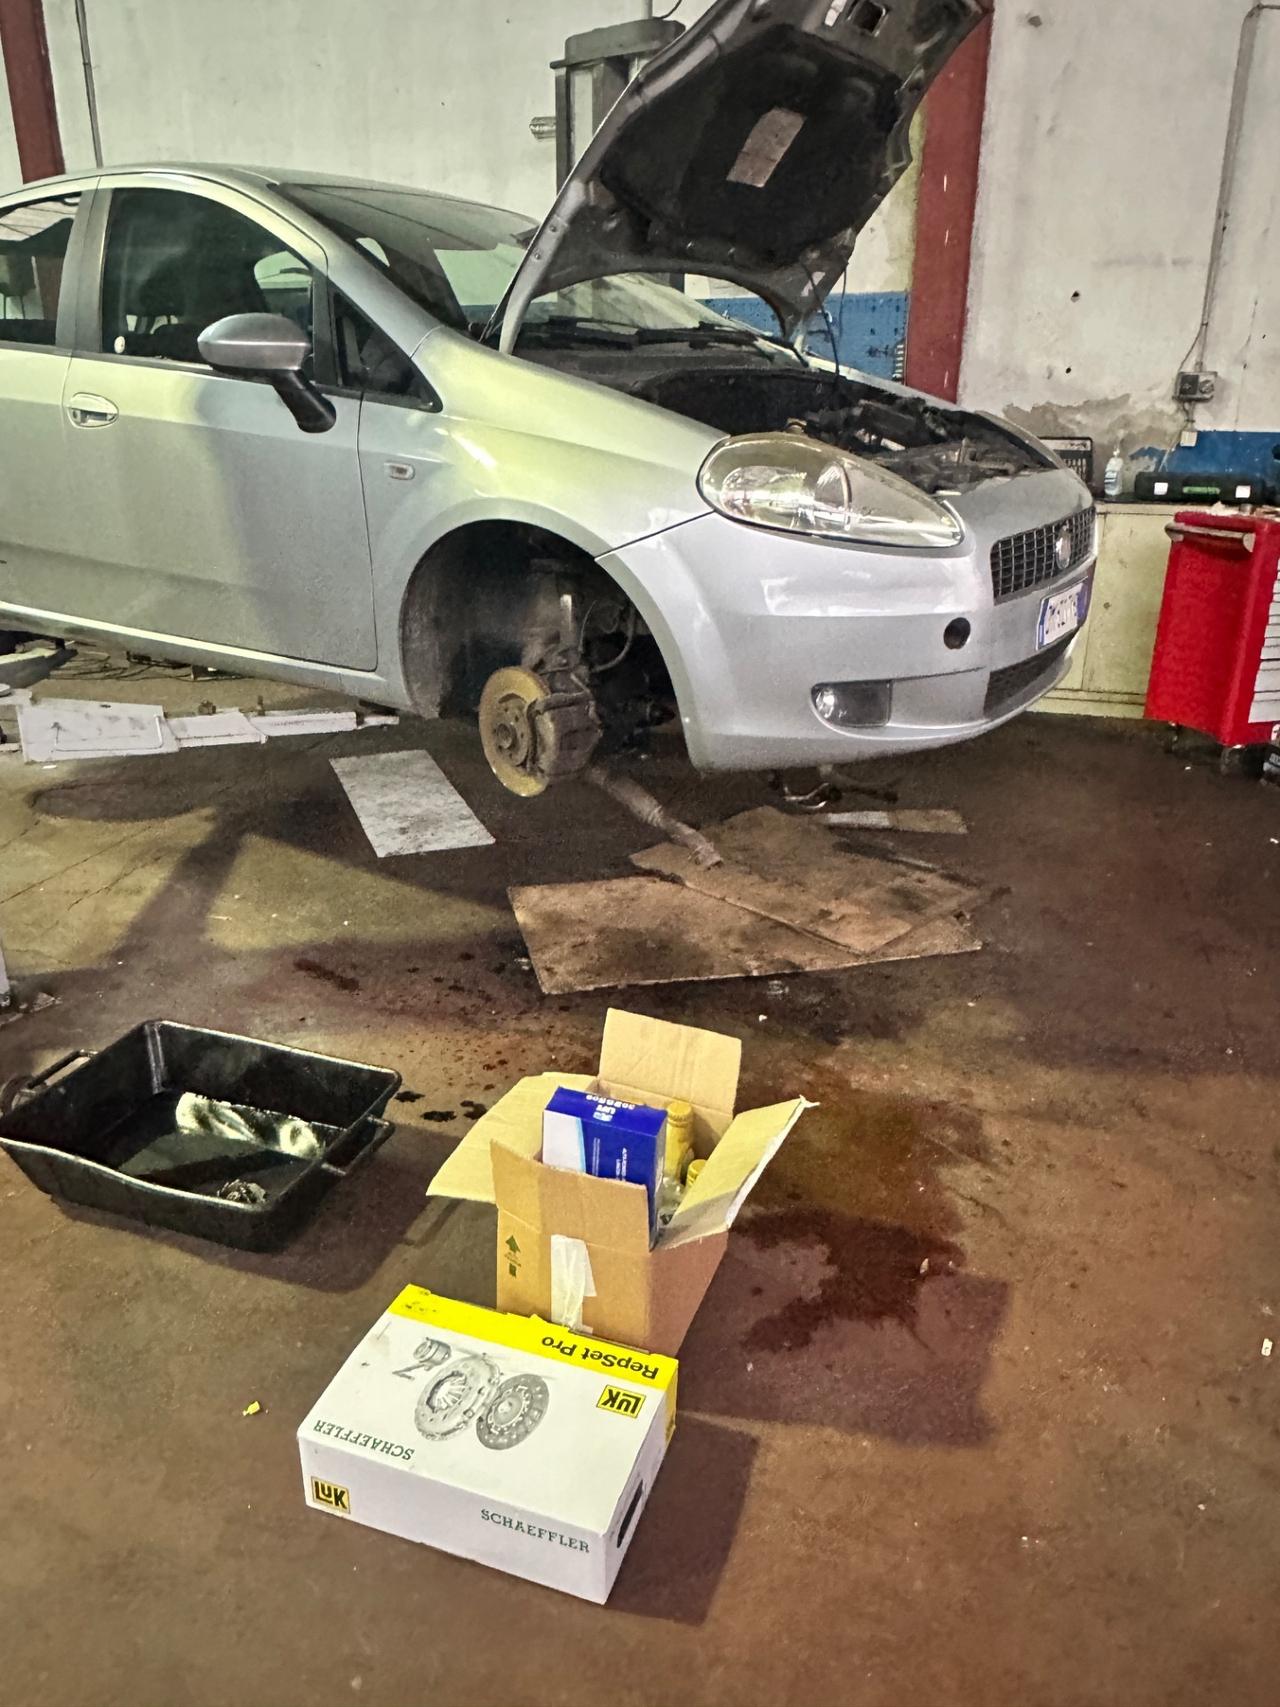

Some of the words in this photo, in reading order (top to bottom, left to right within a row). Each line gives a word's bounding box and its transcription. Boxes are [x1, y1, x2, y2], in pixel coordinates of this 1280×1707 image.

[541, 1336, 578, 1357] Pro
[581, 1347, 660, 1380] RepSet
[312, 1419, 415, 1461] SCHAEFFLER
[480, 1508, 590, 1553] SCHAEFFLER
